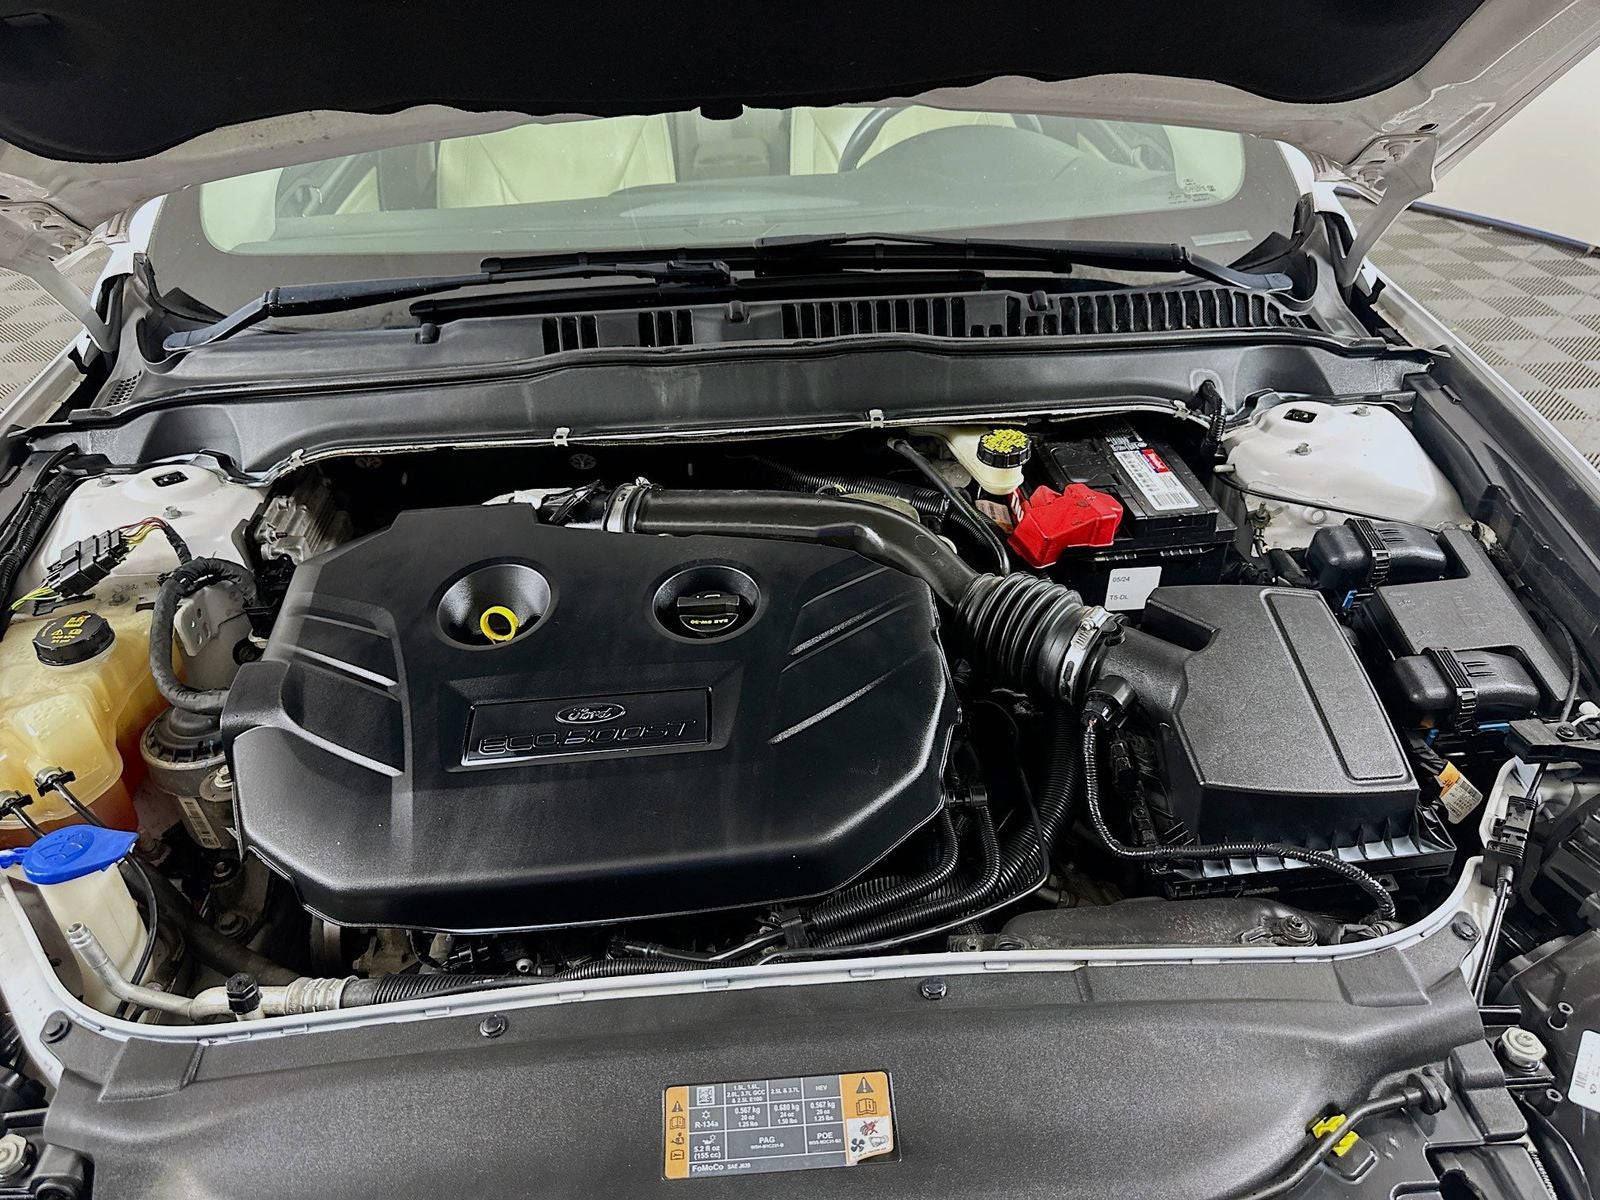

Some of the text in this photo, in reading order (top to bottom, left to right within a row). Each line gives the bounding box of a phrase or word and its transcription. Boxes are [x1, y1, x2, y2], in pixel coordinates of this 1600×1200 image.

[567, 706, 613, 722] Ford
[791, 1104, 800, 1112] kg
[827, 1100, 836, 1109] kg
[752, 1106, 760, 1115] kg
[694, 1152, 709, 1160] (155
[692, 1164, 724, 1172] FoMoCo
